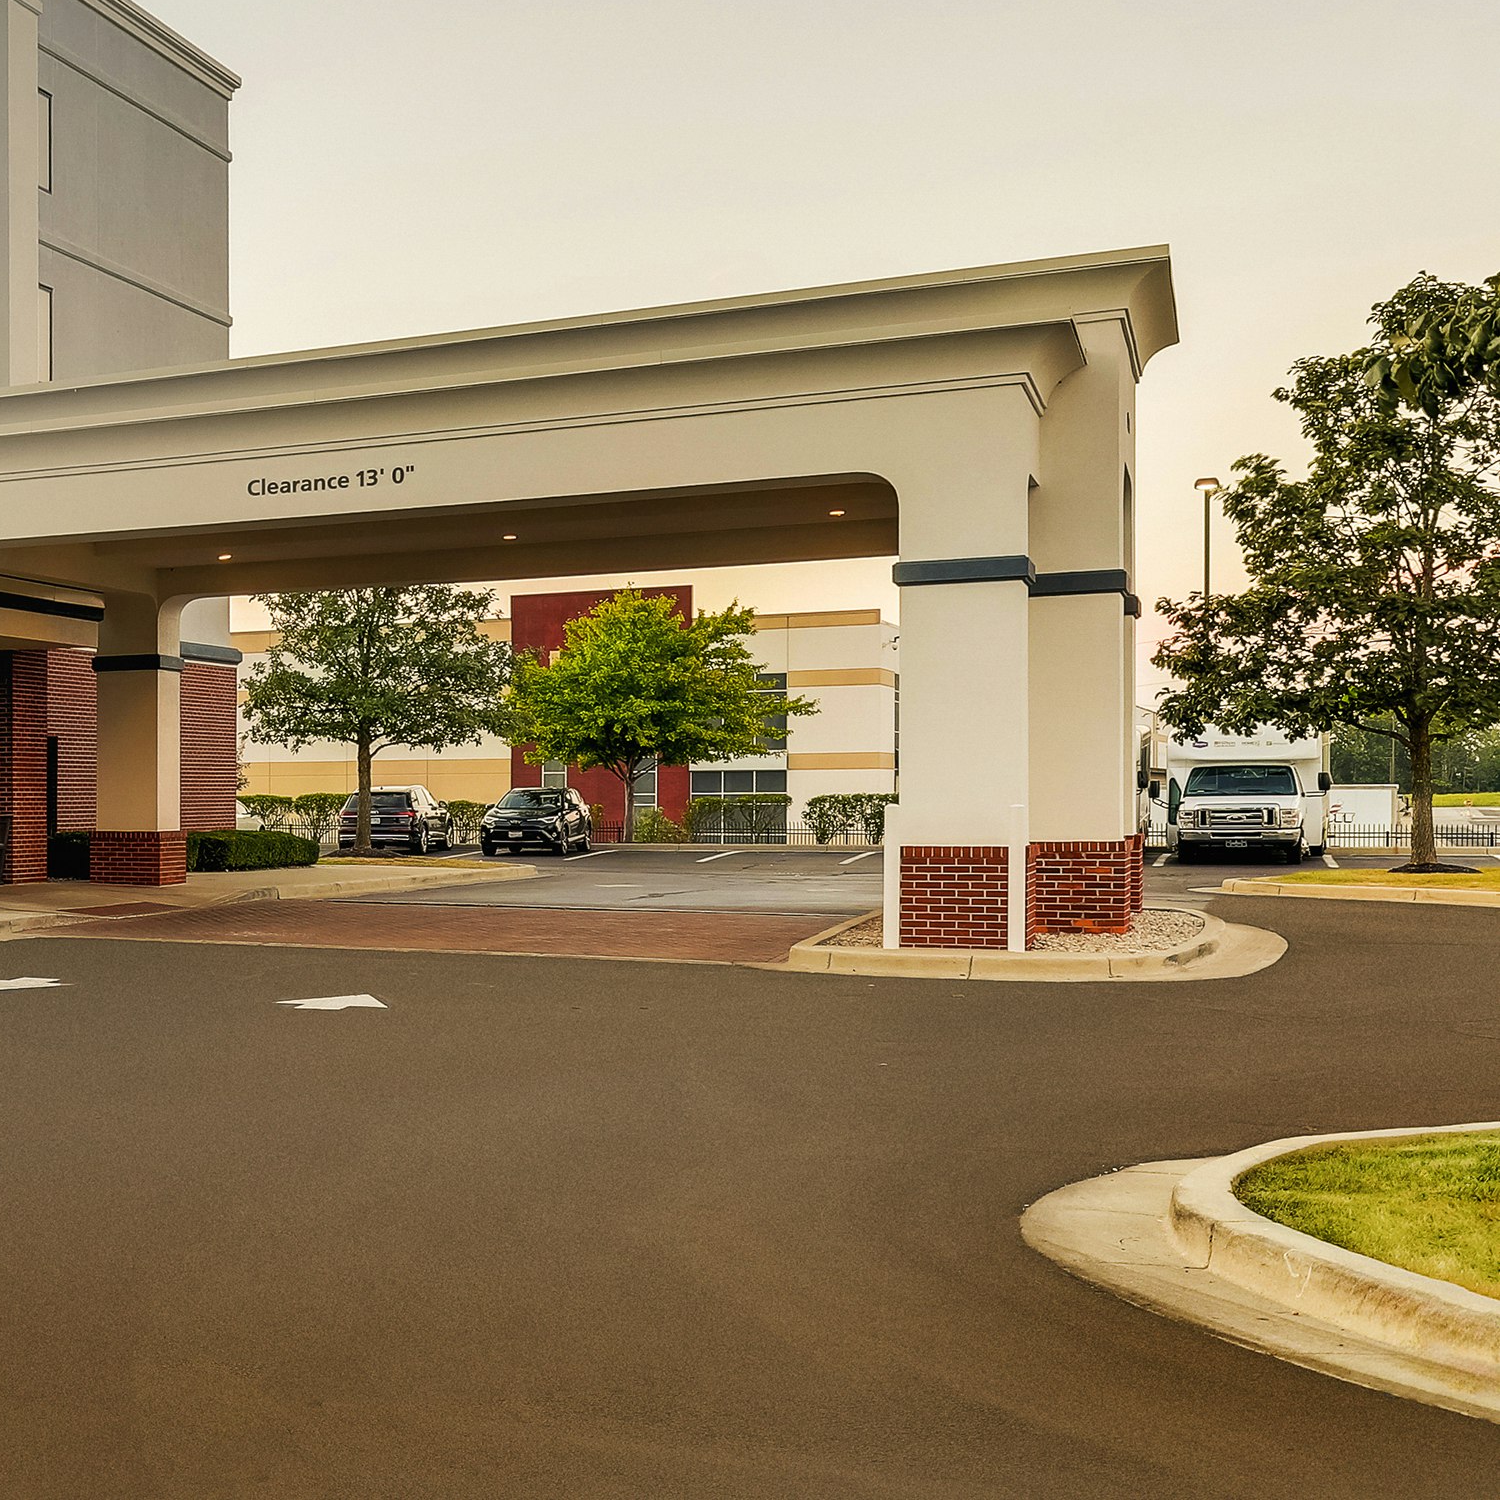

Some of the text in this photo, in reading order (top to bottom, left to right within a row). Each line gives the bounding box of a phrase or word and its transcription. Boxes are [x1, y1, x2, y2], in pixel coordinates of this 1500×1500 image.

[247, 464, 415, 497] Clearance 13' 0"
